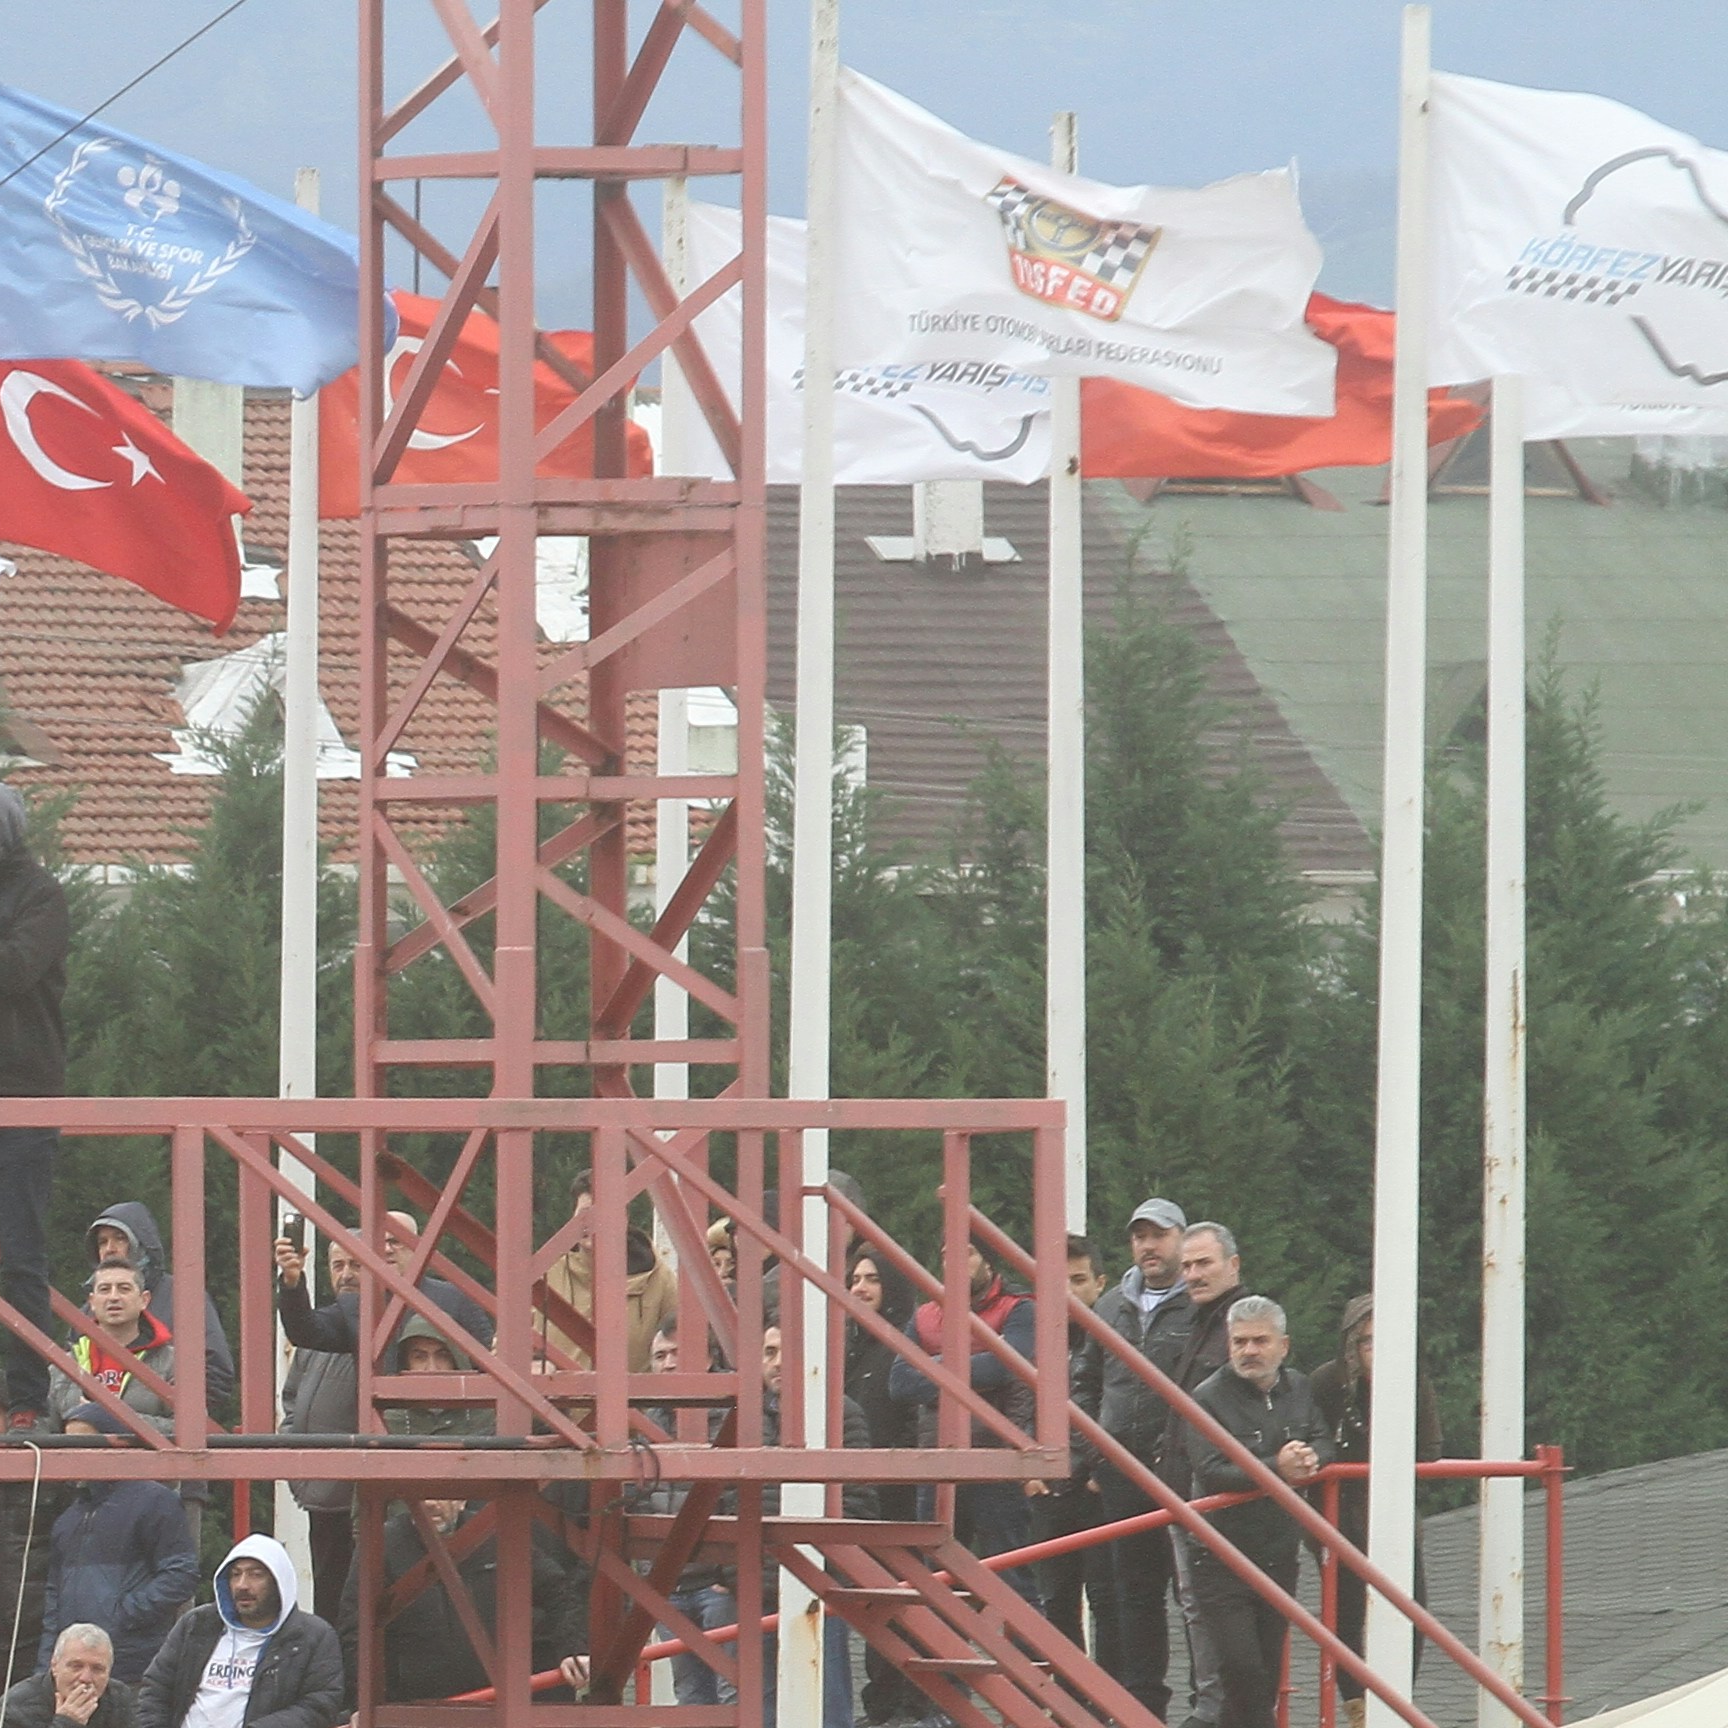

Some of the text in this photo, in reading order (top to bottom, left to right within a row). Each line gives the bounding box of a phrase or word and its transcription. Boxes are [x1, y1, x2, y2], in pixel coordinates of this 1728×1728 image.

[159, 243, 205, 265] SPOR
[909, 309, 980, 332] TÜRKİYE
[1094, 343, 1225, 375] FEDERASYONU
